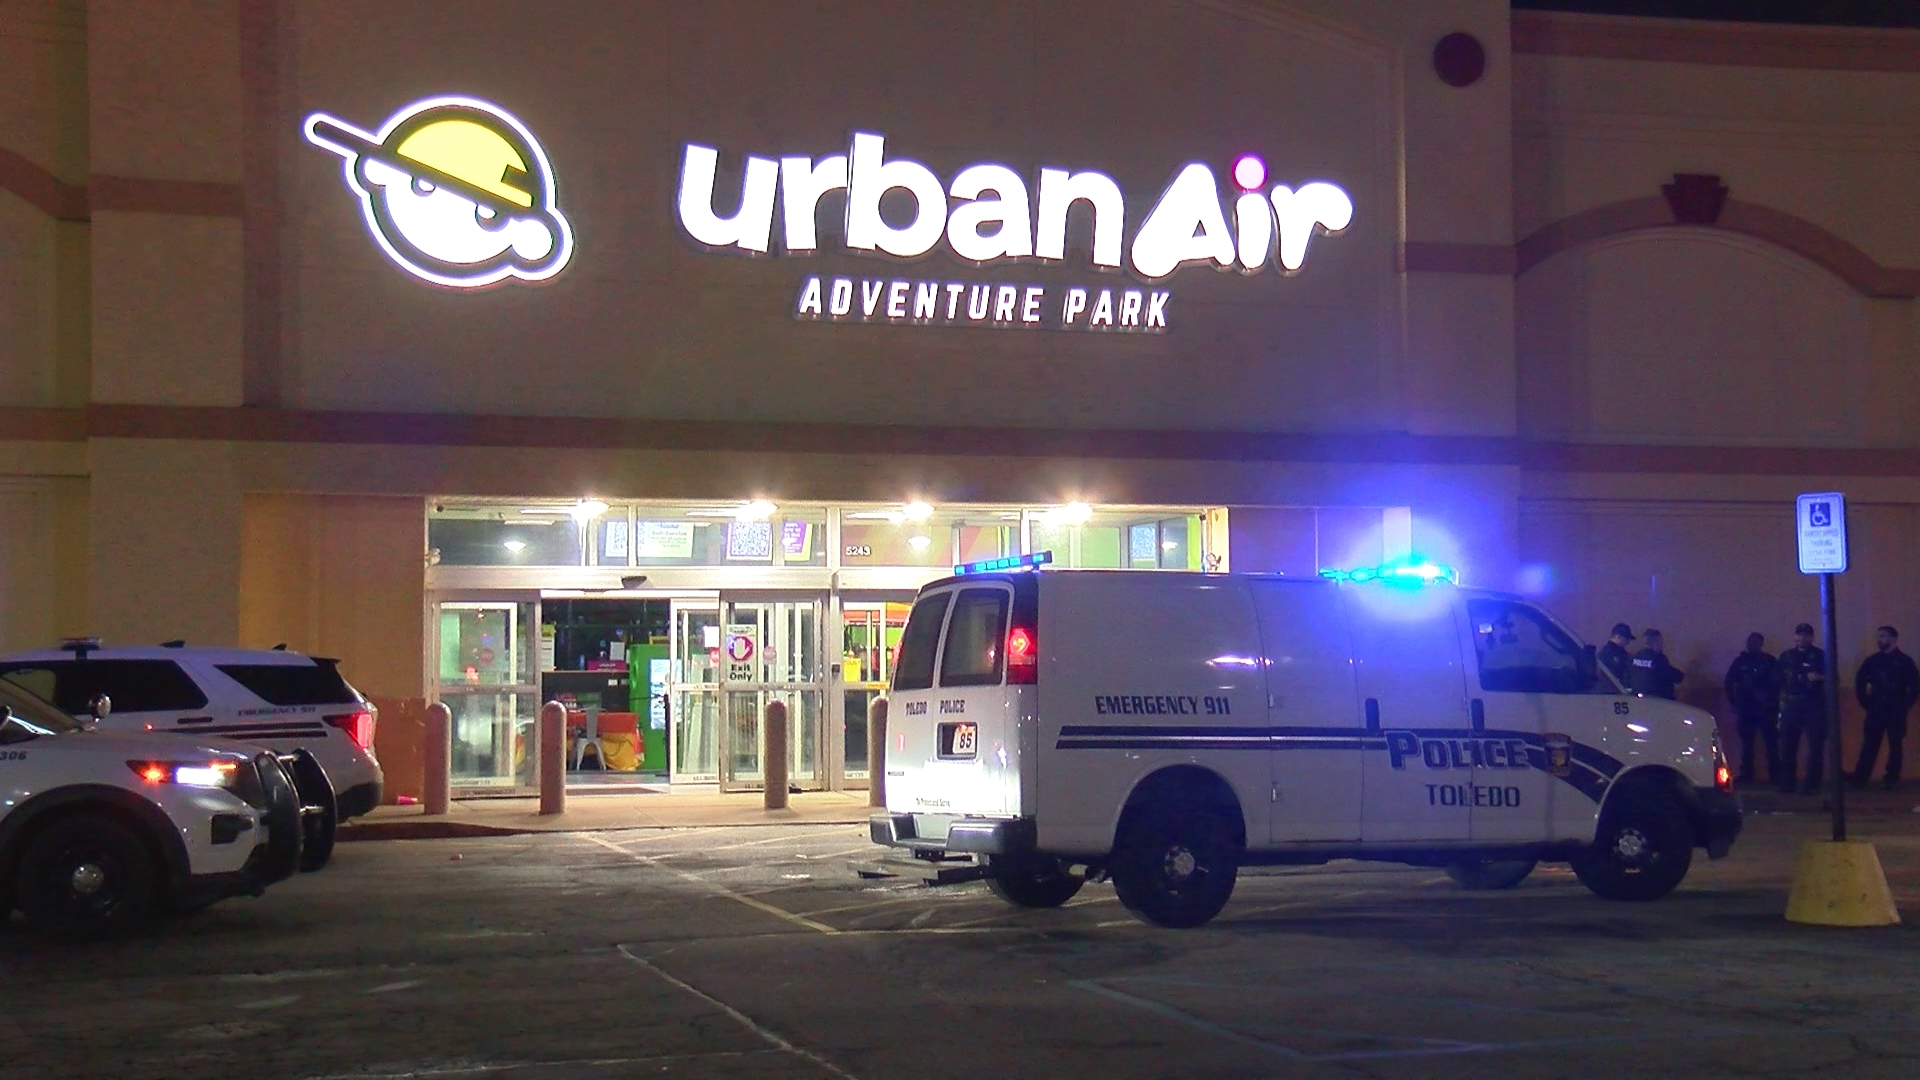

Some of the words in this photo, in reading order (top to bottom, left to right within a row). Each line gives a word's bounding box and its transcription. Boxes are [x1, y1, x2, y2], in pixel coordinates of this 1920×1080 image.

[798, 277, 1044, 323] ADVENTURE
[1063, 288, 1171, 329] PARK
[731, 663, 751, 671] Exit
[730, 672, 753, 681] Only
[906, 701, 928, 715] TOLEDO
[940, 699, 965, 714] POLICE
[1094, 695, 1199, 715] EMERGENCY
[1203, 695, 1231, 715] 911
[1613, 701, 1630, 715] 85
[959, 732, 973, 748] 85
[0, 750, 27, 760] 306
[1384, 730, 1529, 770] POLICE
[1425, 784, 1521, 807] TOLEDO
